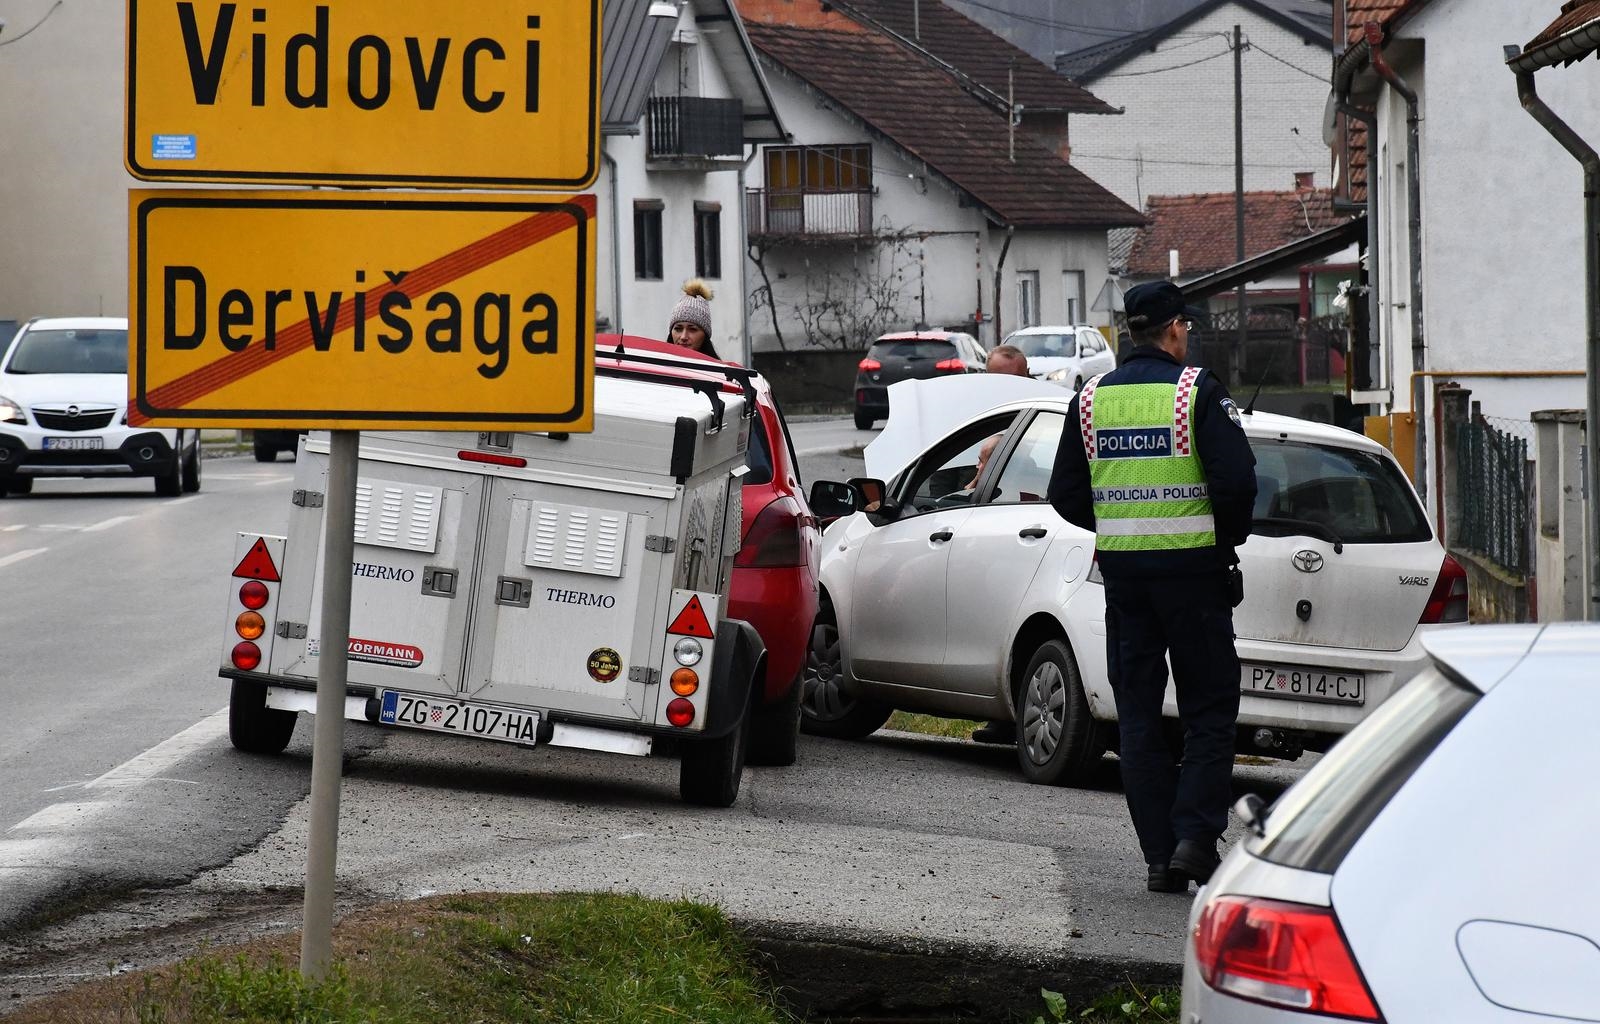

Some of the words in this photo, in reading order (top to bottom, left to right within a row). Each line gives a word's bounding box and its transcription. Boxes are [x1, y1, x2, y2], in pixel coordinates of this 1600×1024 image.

[176, 2, 541, 113] Vidovci
[164, 265, 559, 380] Dervišaga
[1099, 434, 1168, 451] POLICIJA
[1108, 489, 1158, 502] POLICIJA
[1163, 486, 1208, 500] POLICIJ
[1399, 575, 1430, 587] YARIS
[546, 587, 616, 609] THERMO
[382, 710, 395, 719] HR
[398, 697, 428, 724] ZG
